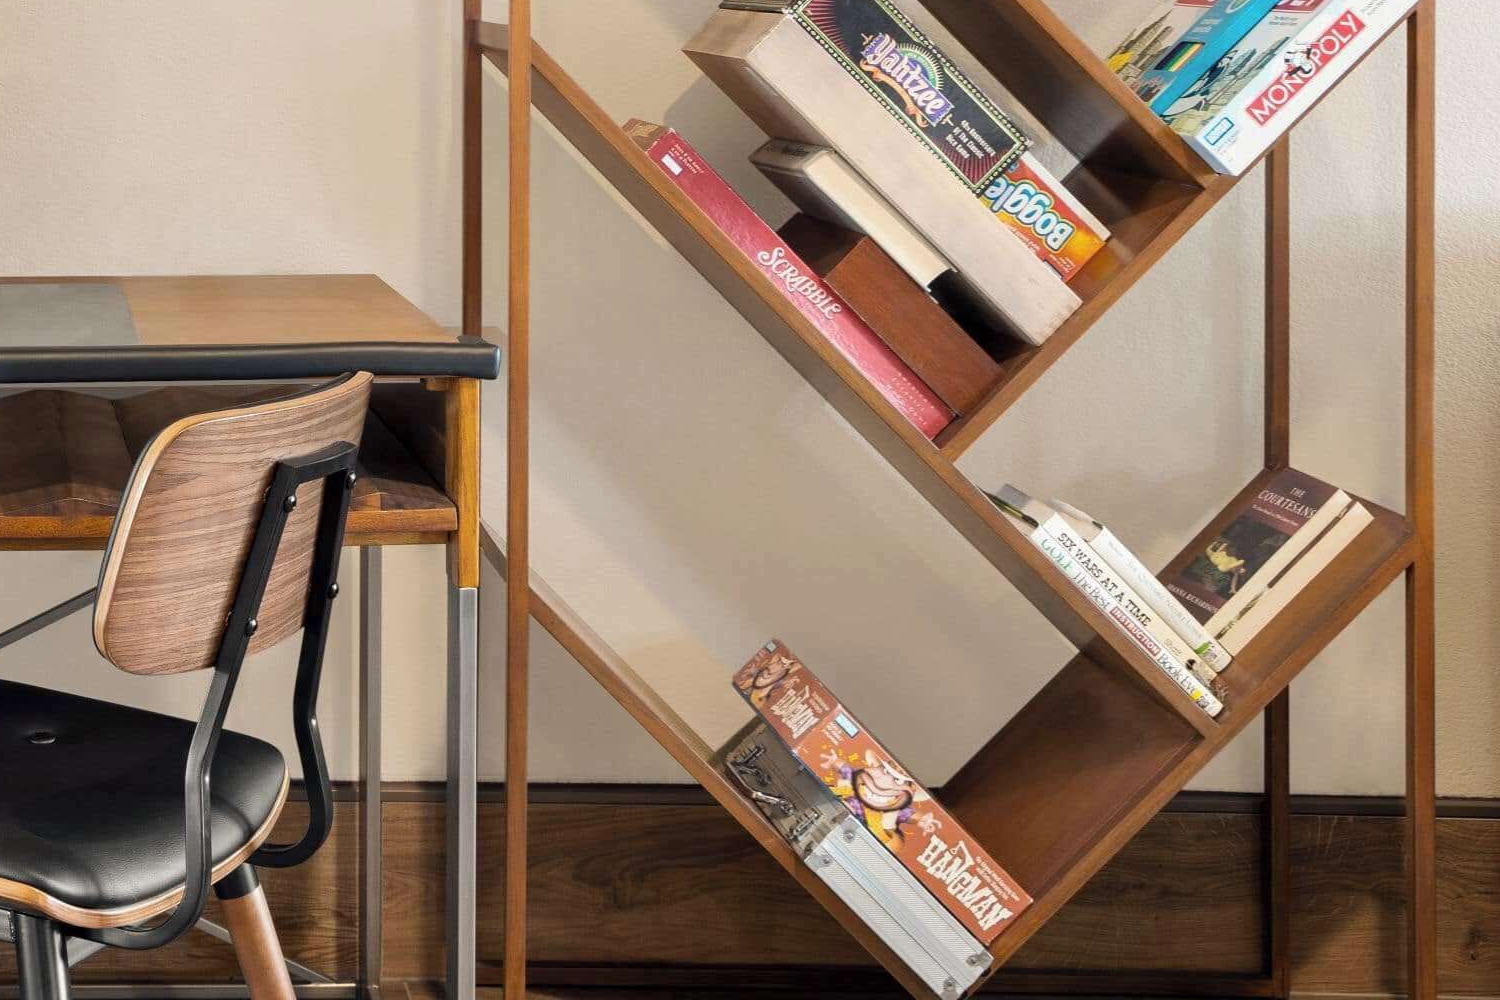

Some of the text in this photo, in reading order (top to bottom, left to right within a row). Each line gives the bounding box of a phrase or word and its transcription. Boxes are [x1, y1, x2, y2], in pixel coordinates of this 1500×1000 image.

[867, 34, 946, 116] Yahtzee
[983, 176, 1074, 250] Boggle
[1290, 487, 1305, 497] THE
[1038, 536, 1077, 572] GOLF
[1070, 570, 1093, 593] The
[1087, 586, 1112, 610] Best
[1110, 608, 1160, 654] INSTRUCTION
[1156, 652, 1185, 680] Book
[1055, 531, 1152, 627] SIX WARS AT A TIME
[916, 834, 1013, 930] HANGMAN
